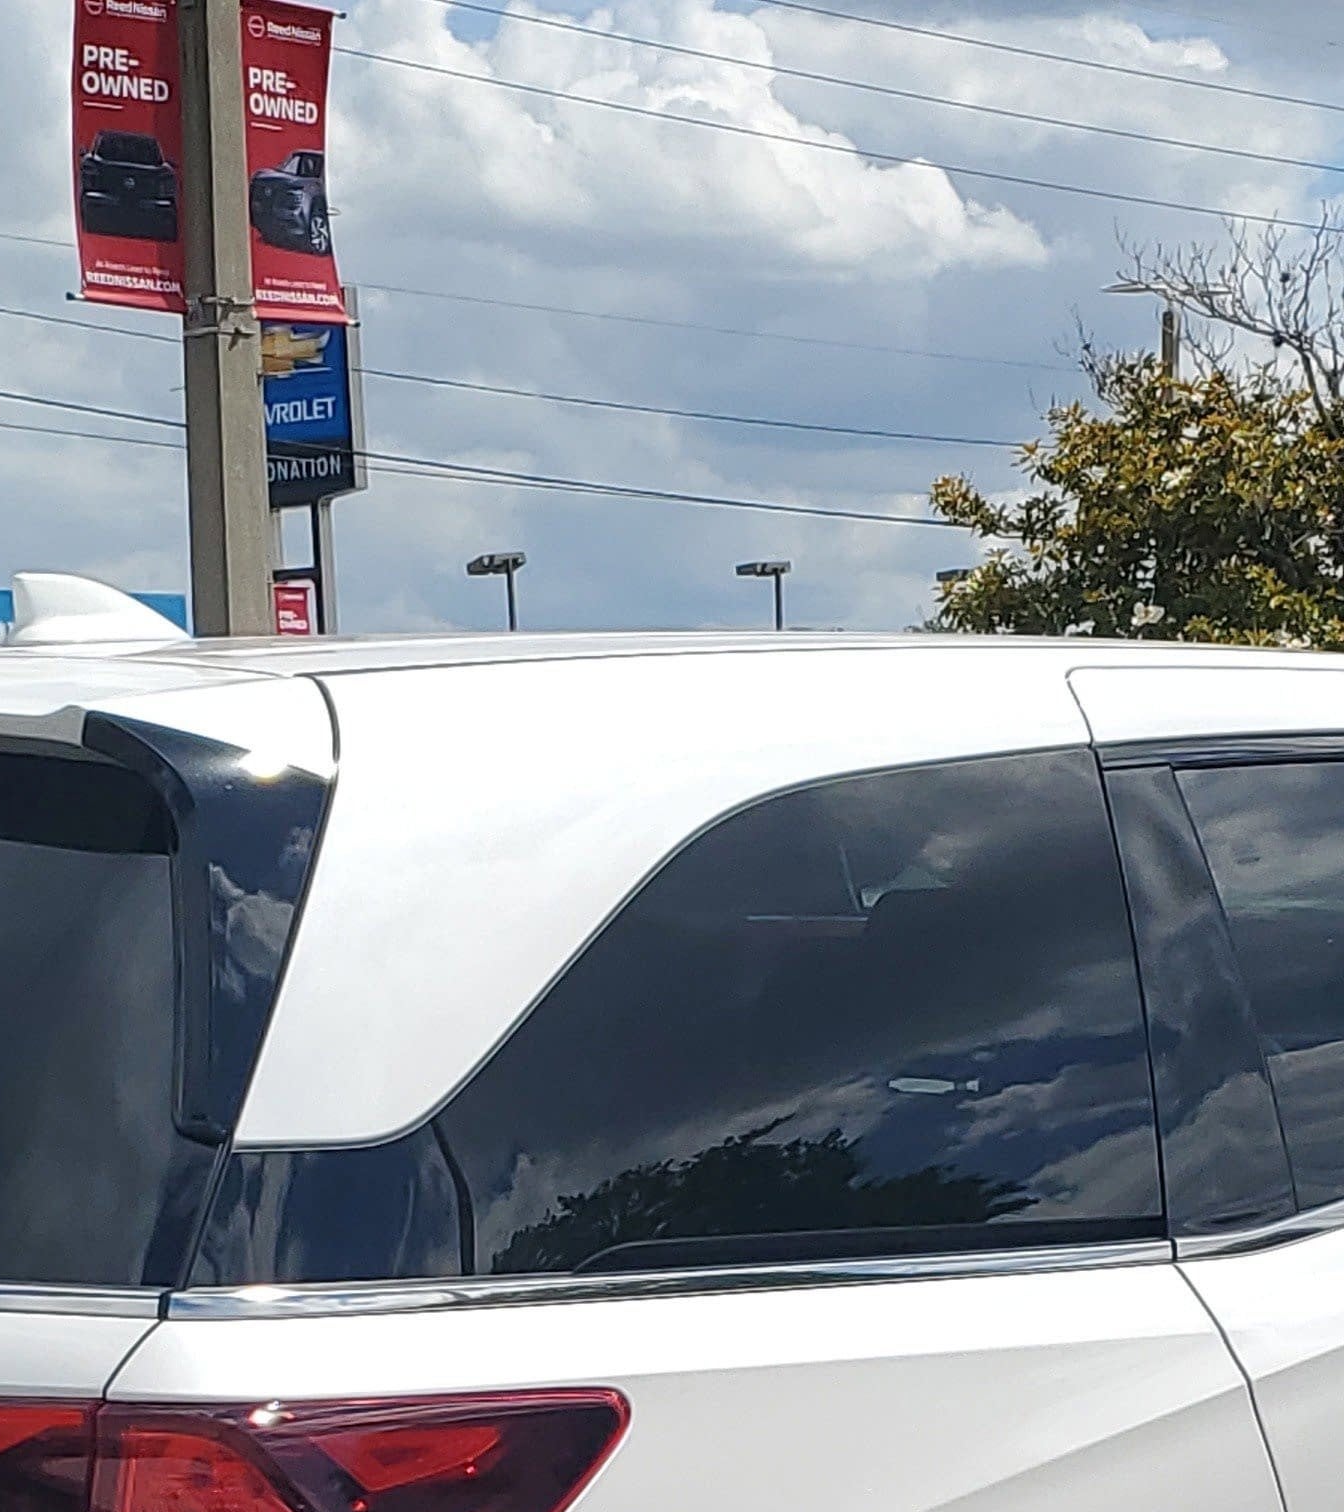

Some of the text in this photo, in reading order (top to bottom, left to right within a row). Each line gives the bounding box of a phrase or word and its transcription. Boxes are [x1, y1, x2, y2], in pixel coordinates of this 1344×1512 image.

[83, 44, 140, 72] PRE-
[82, 70, 169, 102] OWNED
[248, 67, 297, 95] PRE-
[249, 92, 319, 124] OWNED
[264, 395, 337, 426] VROLET
[267, 454, 342, 483] ONATION
